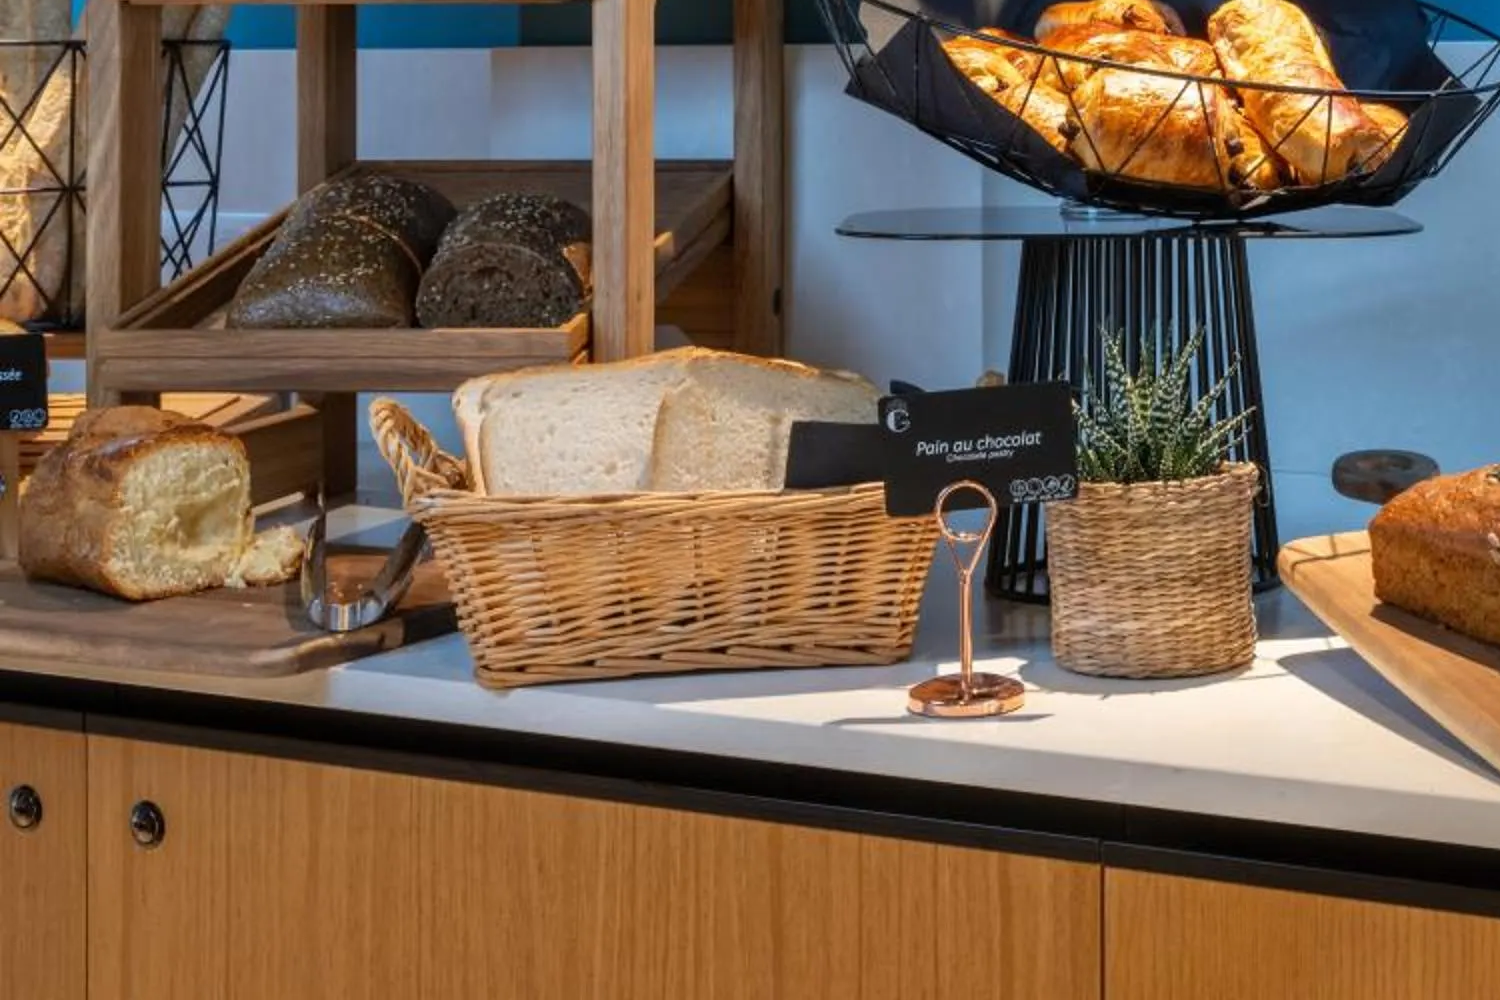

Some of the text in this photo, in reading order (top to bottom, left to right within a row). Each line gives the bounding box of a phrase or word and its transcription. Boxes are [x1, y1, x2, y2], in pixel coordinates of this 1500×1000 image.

[916, 430, 1042, 456] Pain au chocolat
